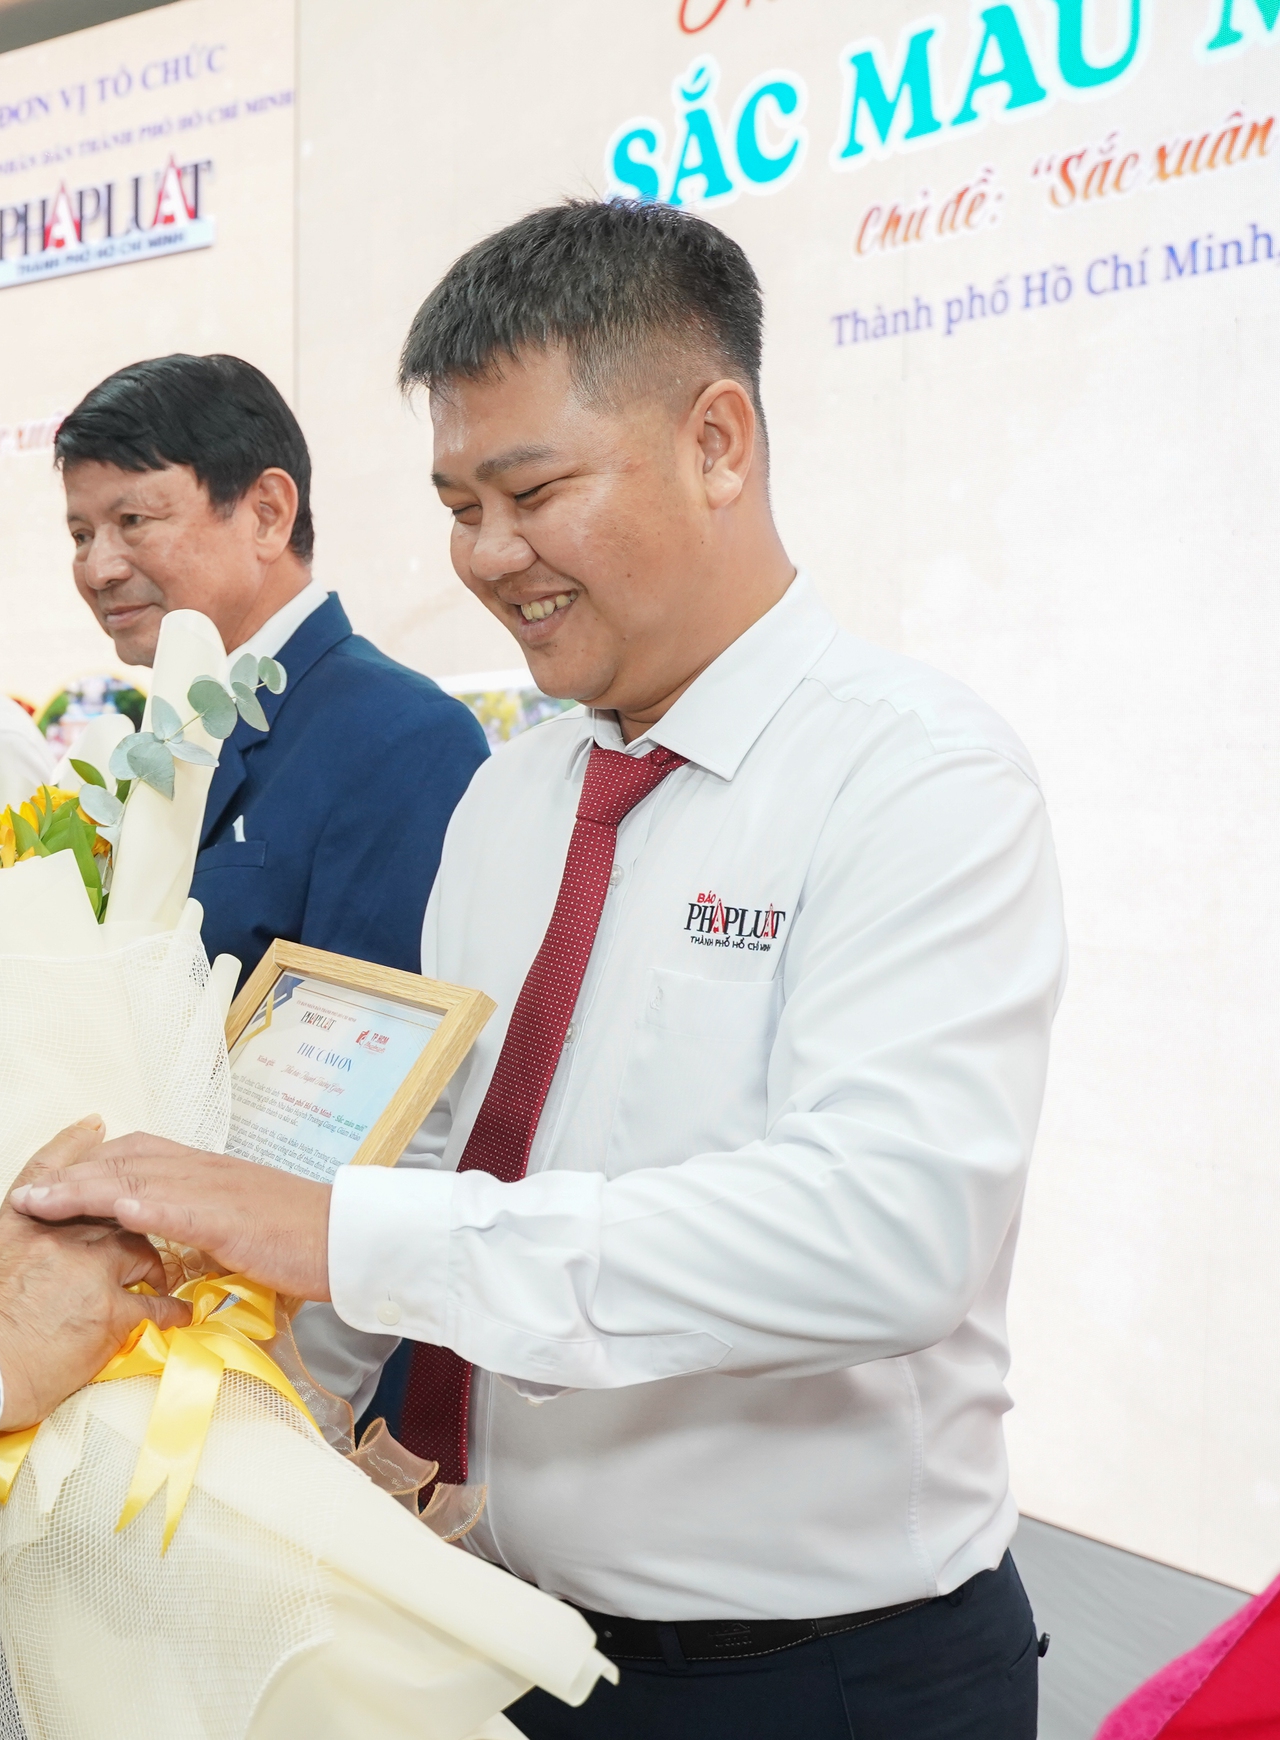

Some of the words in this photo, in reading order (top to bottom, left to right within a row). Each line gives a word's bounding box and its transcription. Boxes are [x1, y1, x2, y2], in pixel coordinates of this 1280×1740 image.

[612, 66, 799, 206] SẮC
[1151, 111, 1276, 182] xuân
[831, 291, 933, 347] Thành
[943, 273, 1009, 336] phố
[1021, 264, 1074, 309] Hồ
[1086, 246, 1149, 296] Chí
[697, 890, 716, 905] BÁO
